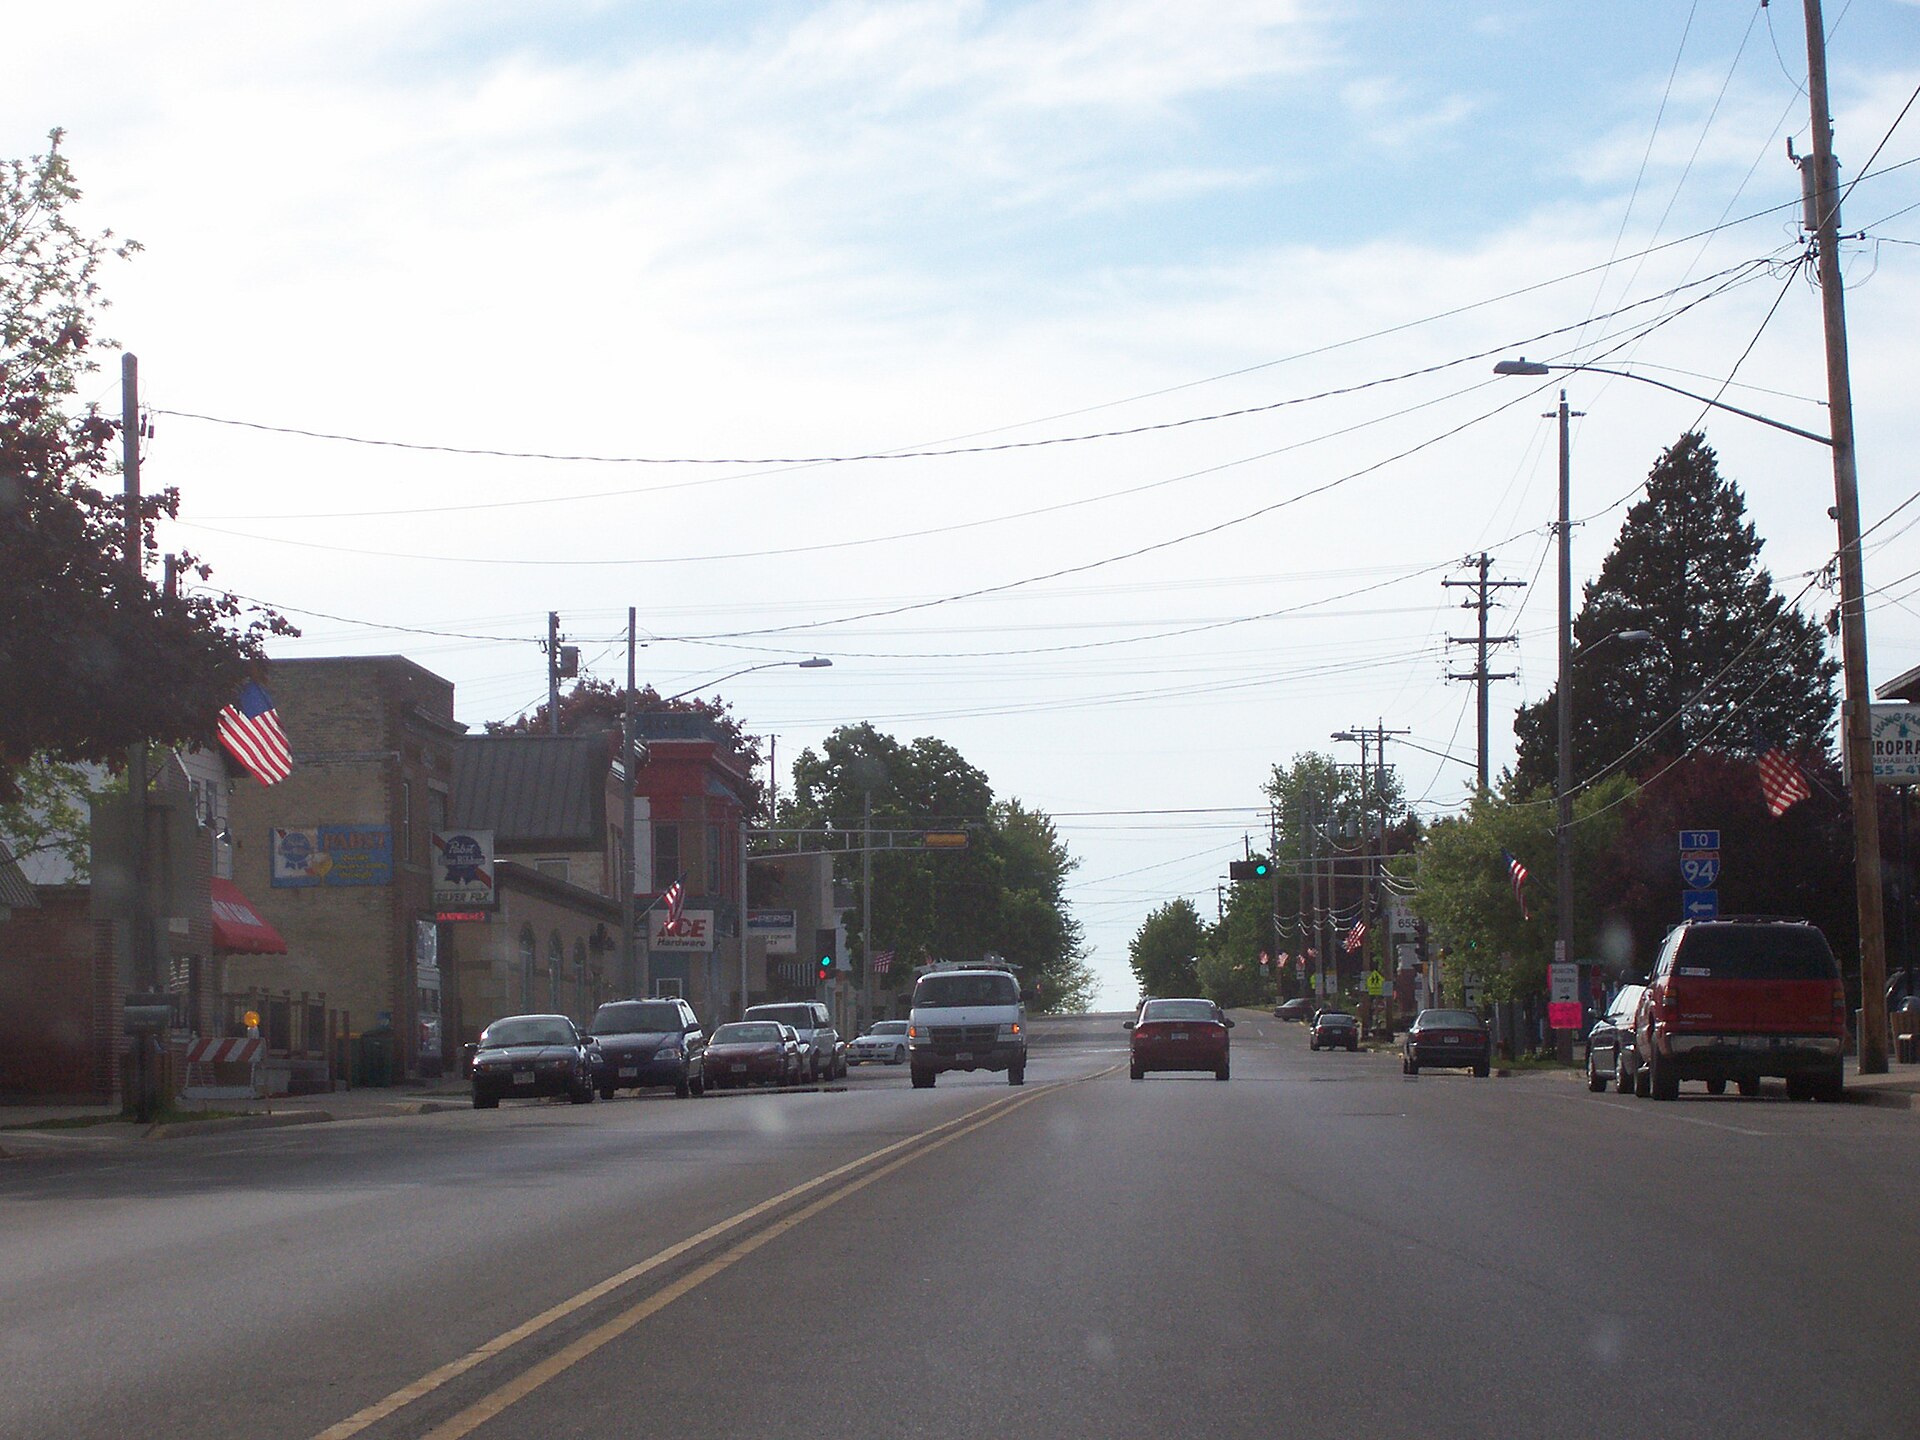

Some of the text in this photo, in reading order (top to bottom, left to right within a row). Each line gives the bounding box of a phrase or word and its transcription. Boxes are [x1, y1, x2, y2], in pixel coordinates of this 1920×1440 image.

[324, 831, 385, 850] PABST
[449, 840, 475, 854] Pabst
[1691, 833, 1708, 847] TO
[1684, 860, 1715, 881] 94
[436, 892, 489, 902] SILVER FOX
[757, 914, 792, 923] PEPSI
[656, 937, 706, 947] Hardware
